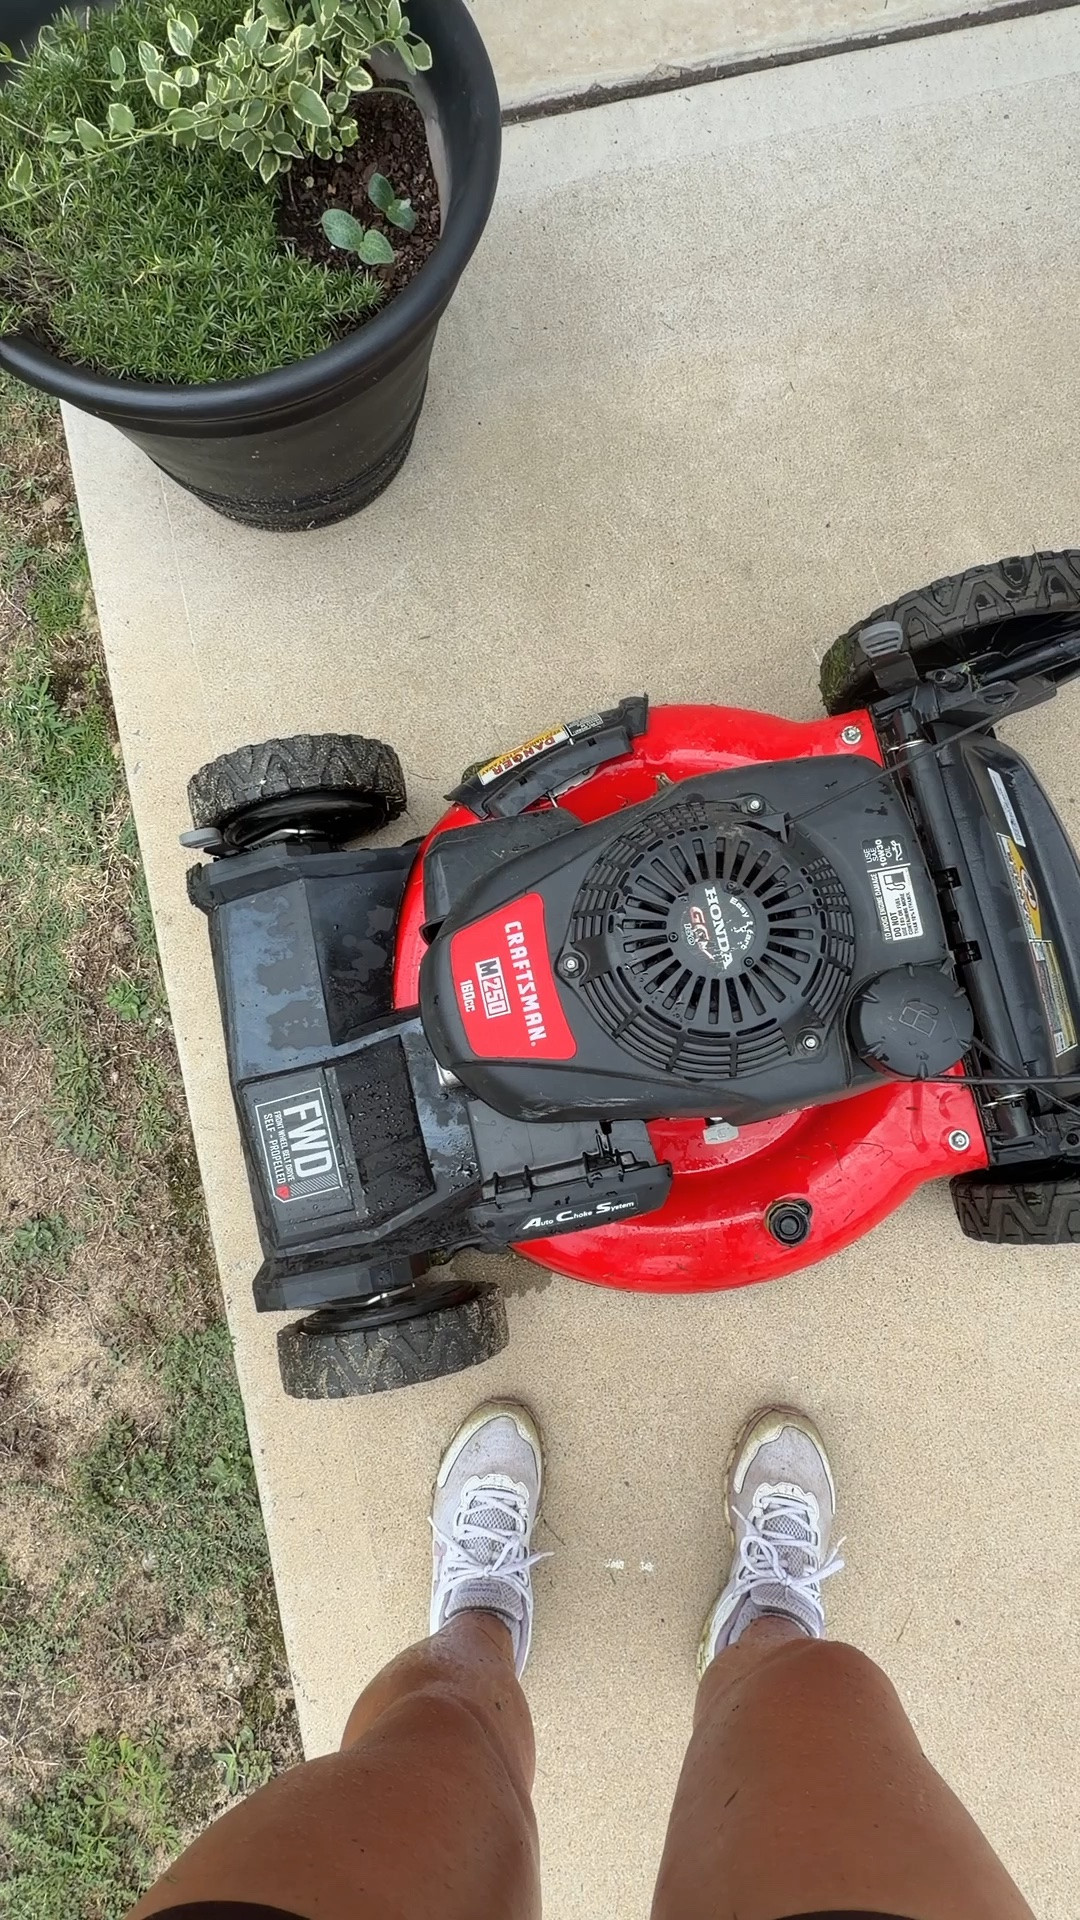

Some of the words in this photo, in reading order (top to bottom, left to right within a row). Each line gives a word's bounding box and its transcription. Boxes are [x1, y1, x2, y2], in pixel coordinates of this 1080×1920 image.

[490, 736, 555, 775] DANGER
[863, 849, 872, 863] USE
[870, 848, 878, 861] SAE
[875, 839, 887, 866] 10W30
[870, 873, 881, 895] DAMAGE
[876, 896, 886, 915] ENGINE
[705, 887, 733, 969] HONDA
[881, 916, 890, 932] AVOID
[890, 912, 899, 925] NOT
[893, 927, 901, 937] DO
[479, 960, 507, 1014] M250
[504, 921, 547, 1041] CRAFTSMAN
[460, 979, 475, 1012] 160cc
[274, 1111, 284, 1129] FRONT
[263, 1113, 275, 1132] SELF
[269, 1140, 286, 1184] PROPELLED
[277, 1130, 288, 1149] WHEEL
[283, 1100, 332, 1178] FWD
[281, 1150, 291, 1163] BELT
[286, 1164, 295, 1182] DRIVE
[522, 1217, 554, 1230] Auto
[556, 1211, 593, 1222] Choke
[596, 1202, 634, 1214] System
